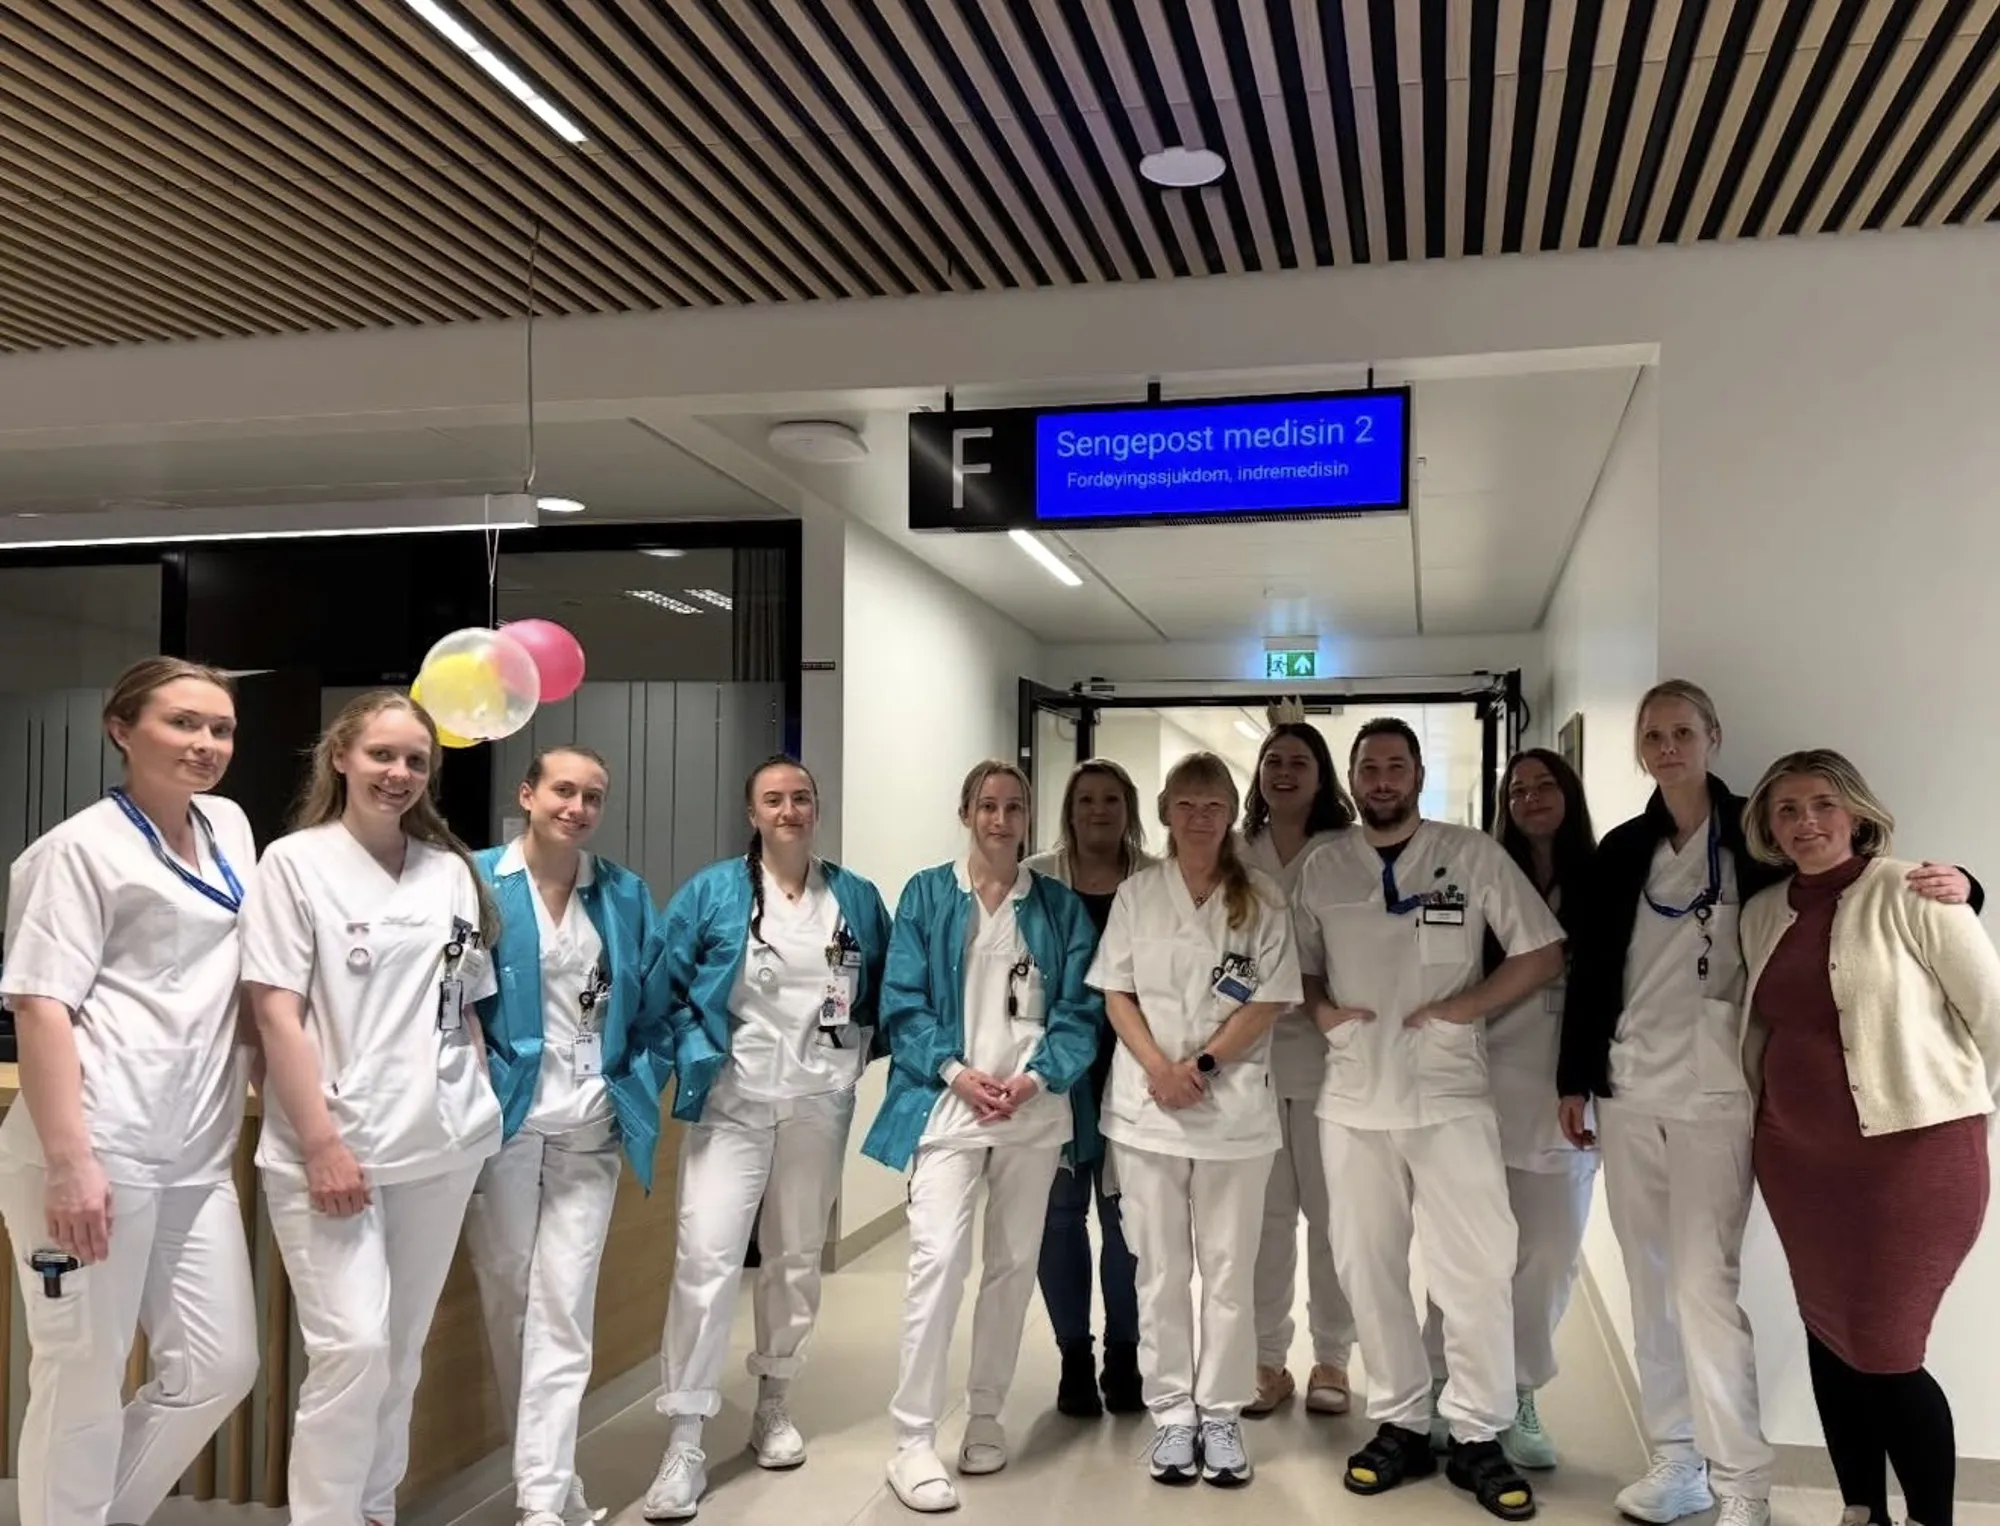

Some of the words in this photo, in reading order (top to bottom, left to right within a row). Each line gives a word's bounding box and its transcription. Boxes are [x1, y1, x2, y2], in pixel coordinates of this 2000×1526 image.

[1056, 428, 1214, 461] Sengepost
[1224, 418, 1344, 449] medisin
[1354, 414, 1374, 444] 2
[952, 428, 993, 509] F
[1066, 467, 1233, 490] Fordøyingssjukdom,
[1237, 460, 1349, 481] indremedisin
